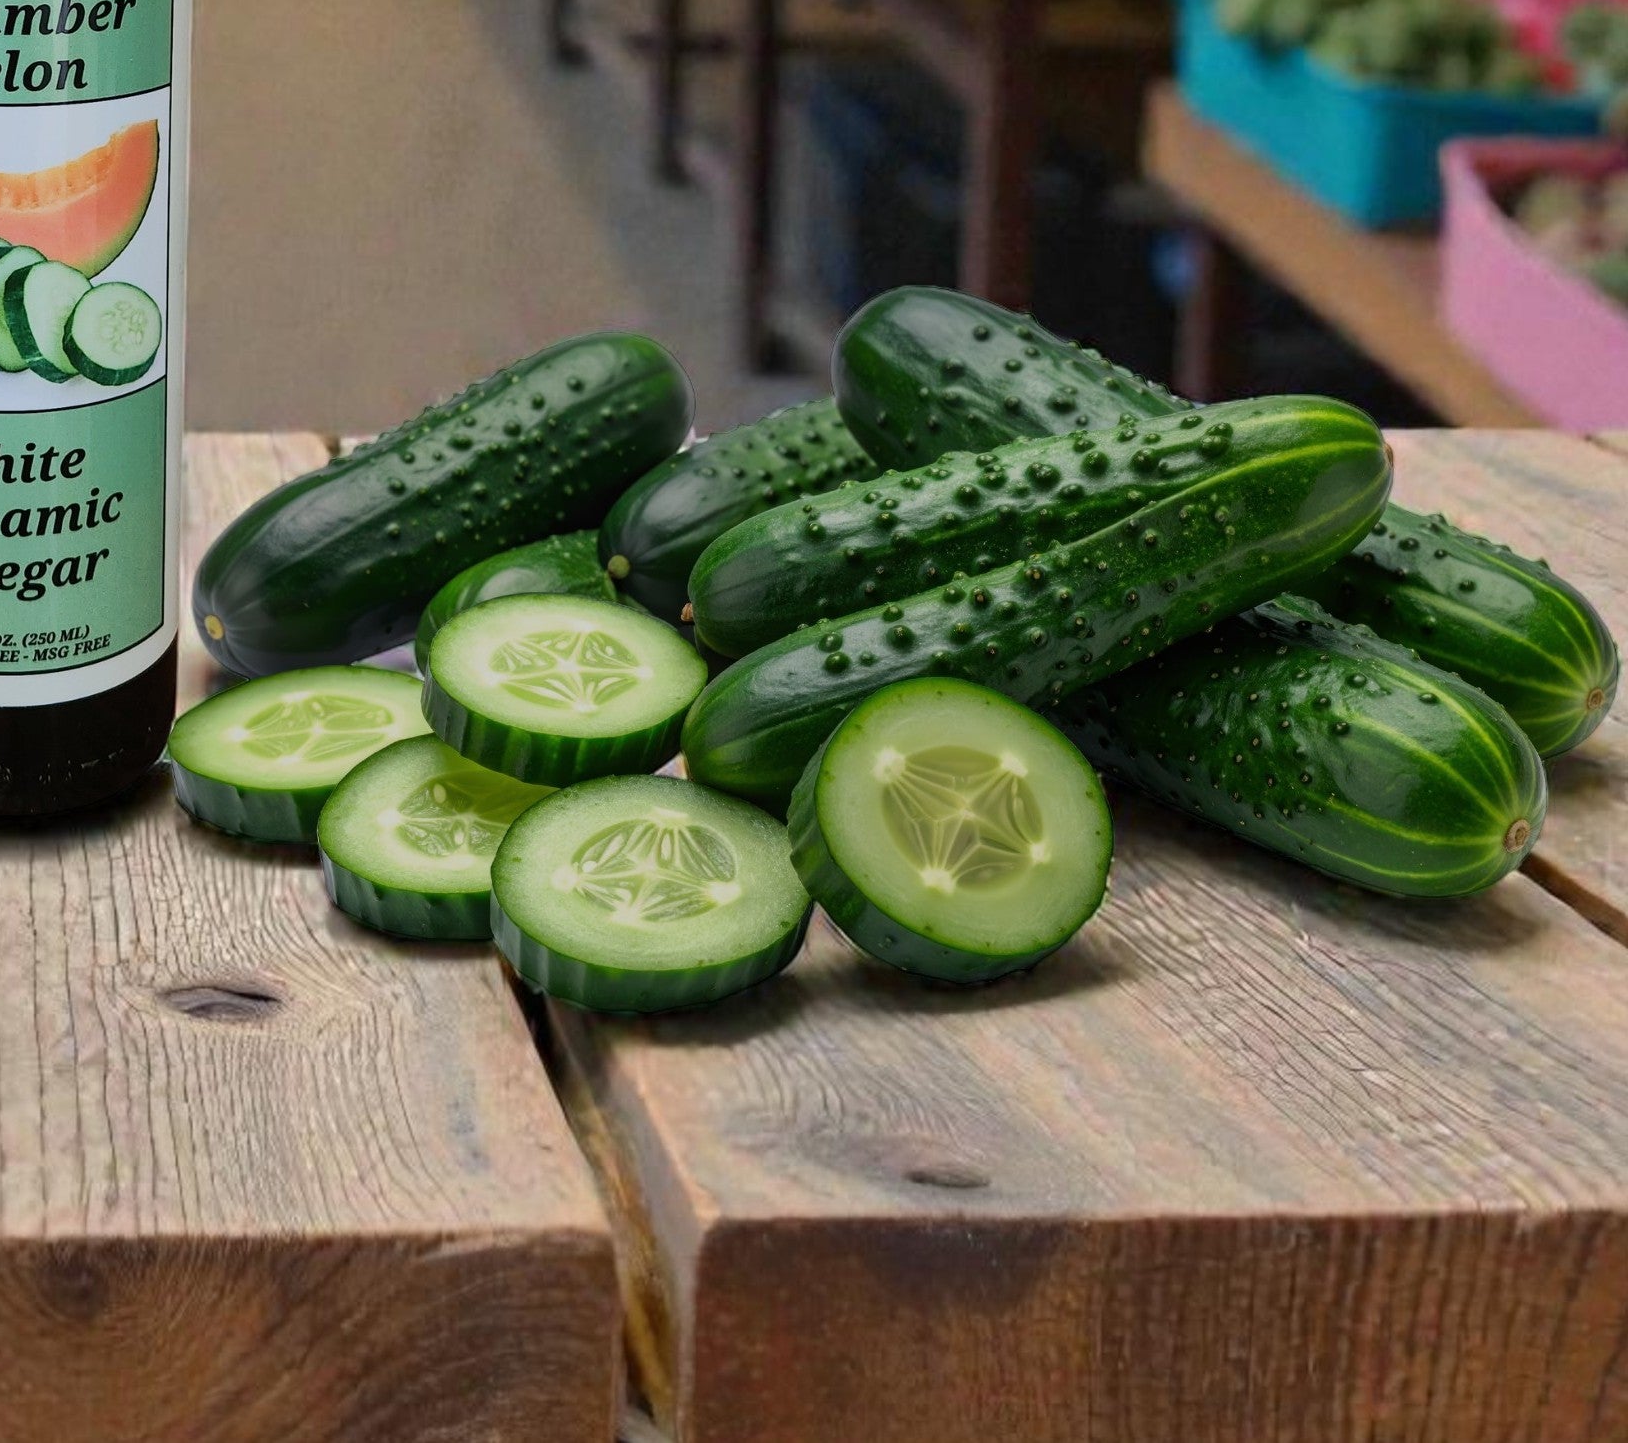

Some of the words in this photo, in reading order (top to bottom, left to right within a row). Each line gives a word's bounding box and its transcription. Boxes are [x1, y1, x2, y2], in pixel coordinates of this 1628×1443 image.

[21, 631, 56, 647] (250
[58, 624, 91, 644] ML)
[32, 646, 69, 662] MSG
[73, 634, 112, 656] FREE
